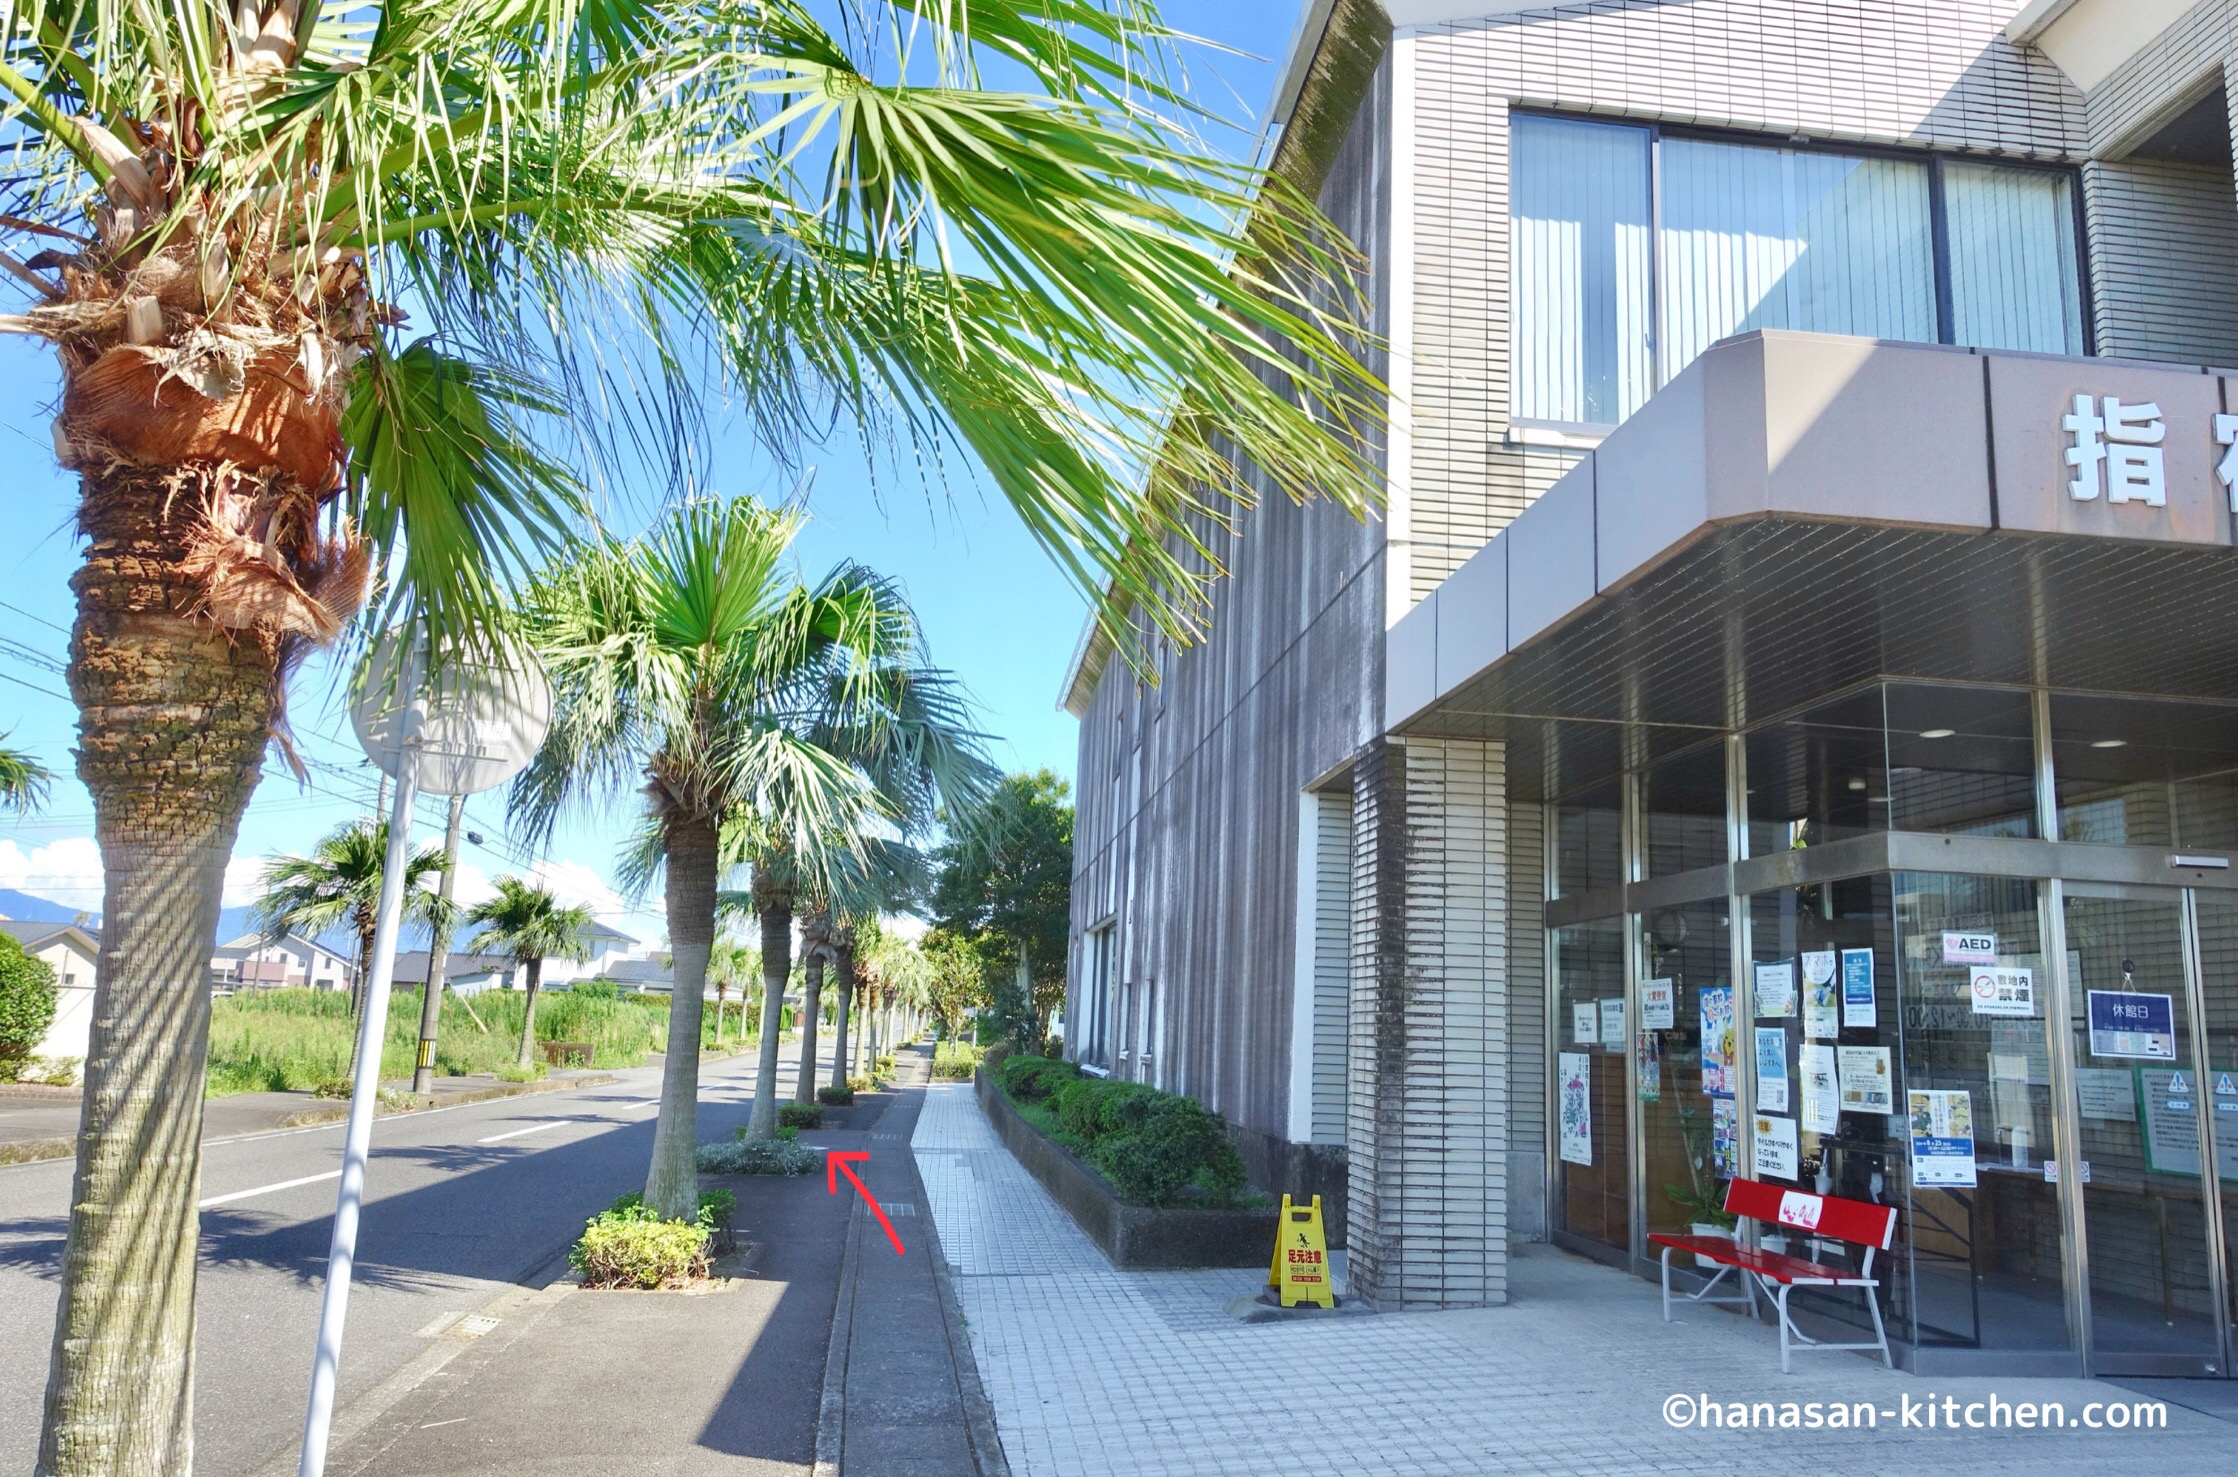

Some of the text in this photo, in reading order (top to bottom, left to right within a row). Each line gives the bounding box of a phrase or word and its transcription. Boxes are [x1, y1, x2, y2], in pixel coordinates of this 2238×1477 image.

[1959, 938, 1992, 950] AED
[1997, 974, 2029, 987] 敷地内
[1998, 988, 2030, 1002] 禁煙
[2112, 1003, 2149, 1019] 休館日
[1288, 1249, 1322, 1264] 足元注意
